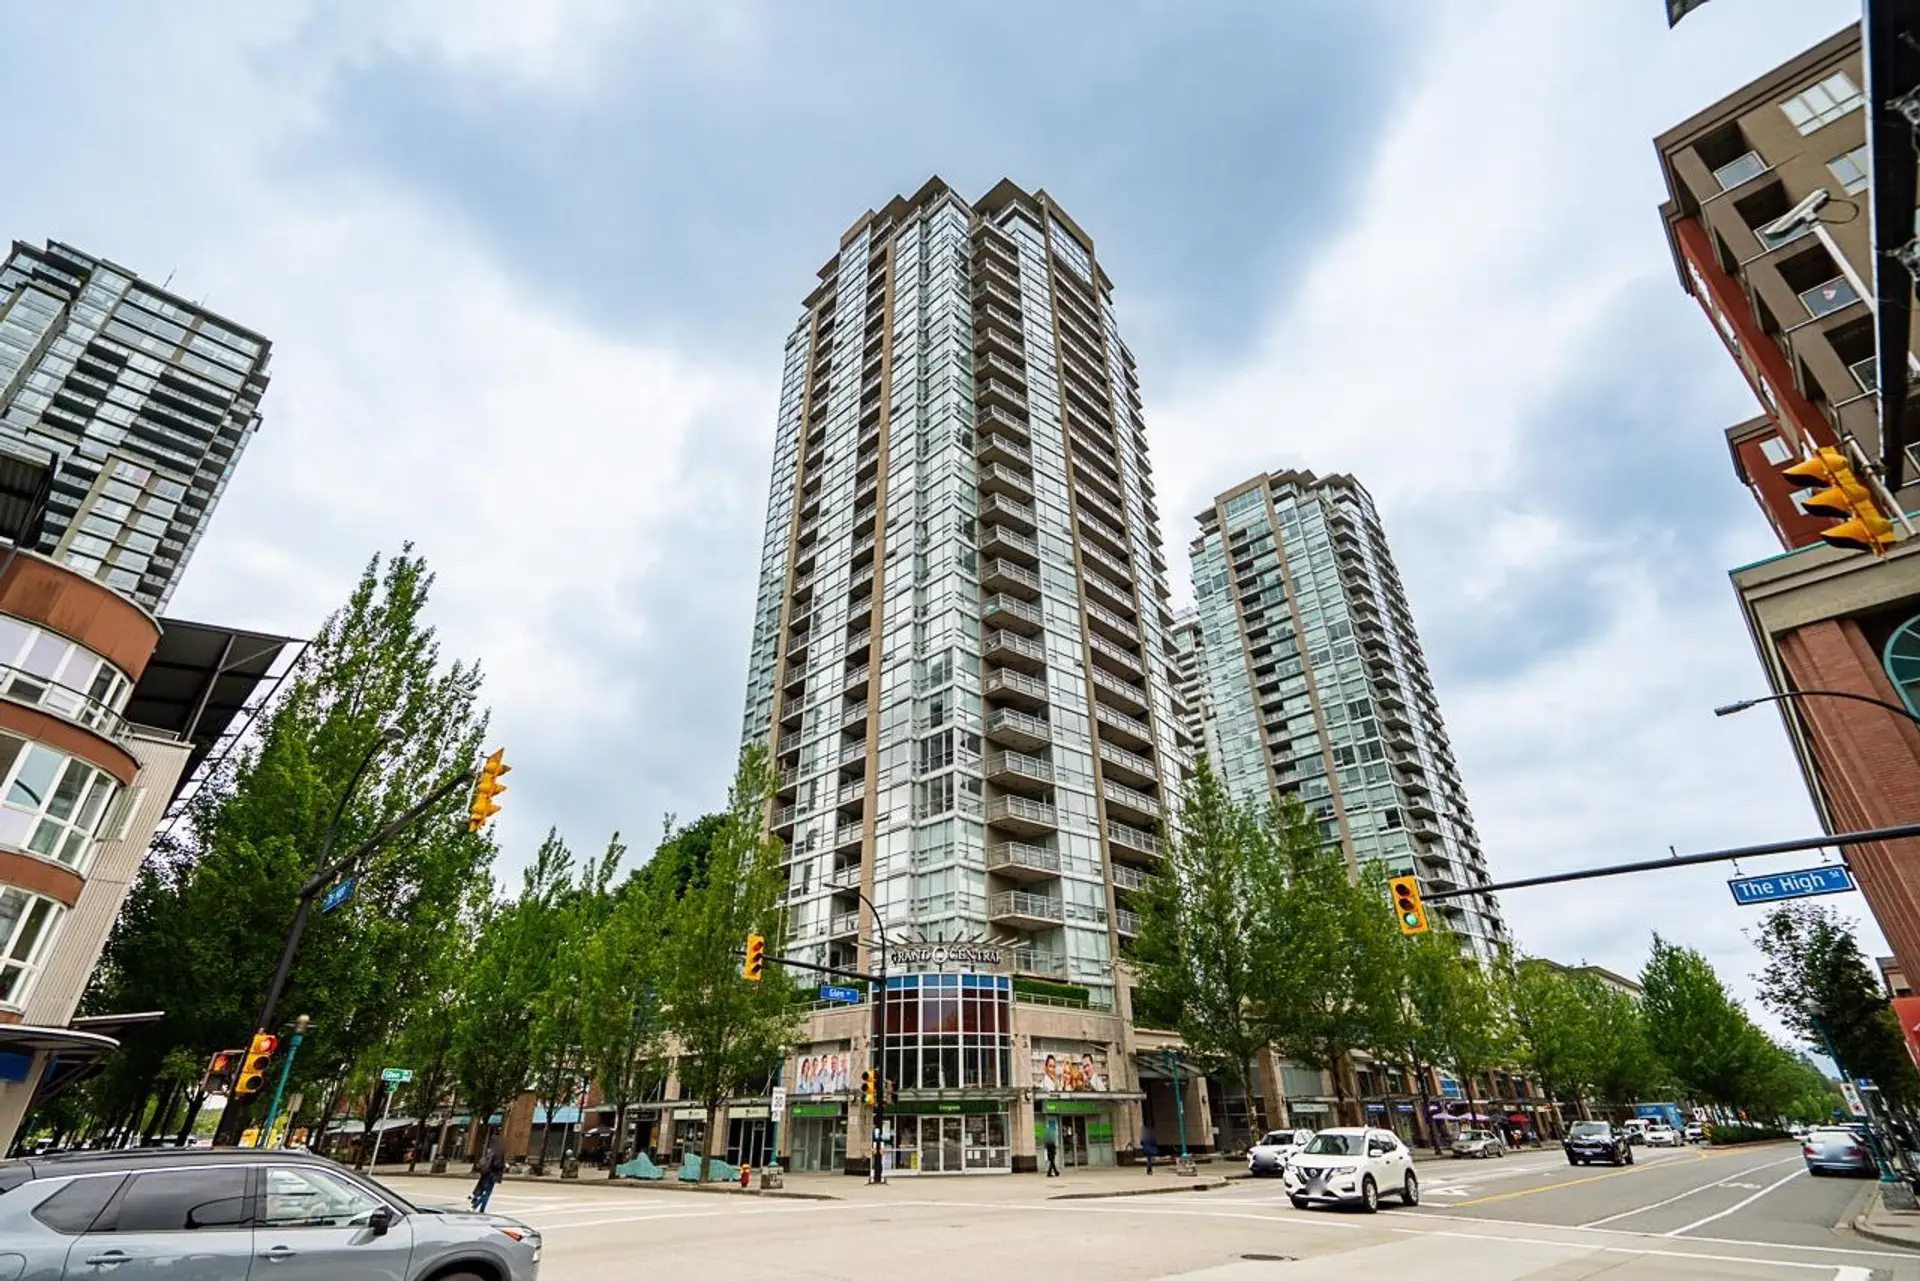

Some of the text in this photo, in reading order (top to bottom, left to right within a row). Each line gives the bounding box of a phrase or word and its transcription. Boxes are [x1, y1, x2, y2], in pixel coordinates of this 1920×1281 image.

[1738, 871, 1840, 897] The High St
[891, 947, 1001, 964] GRAND CENTRAL
